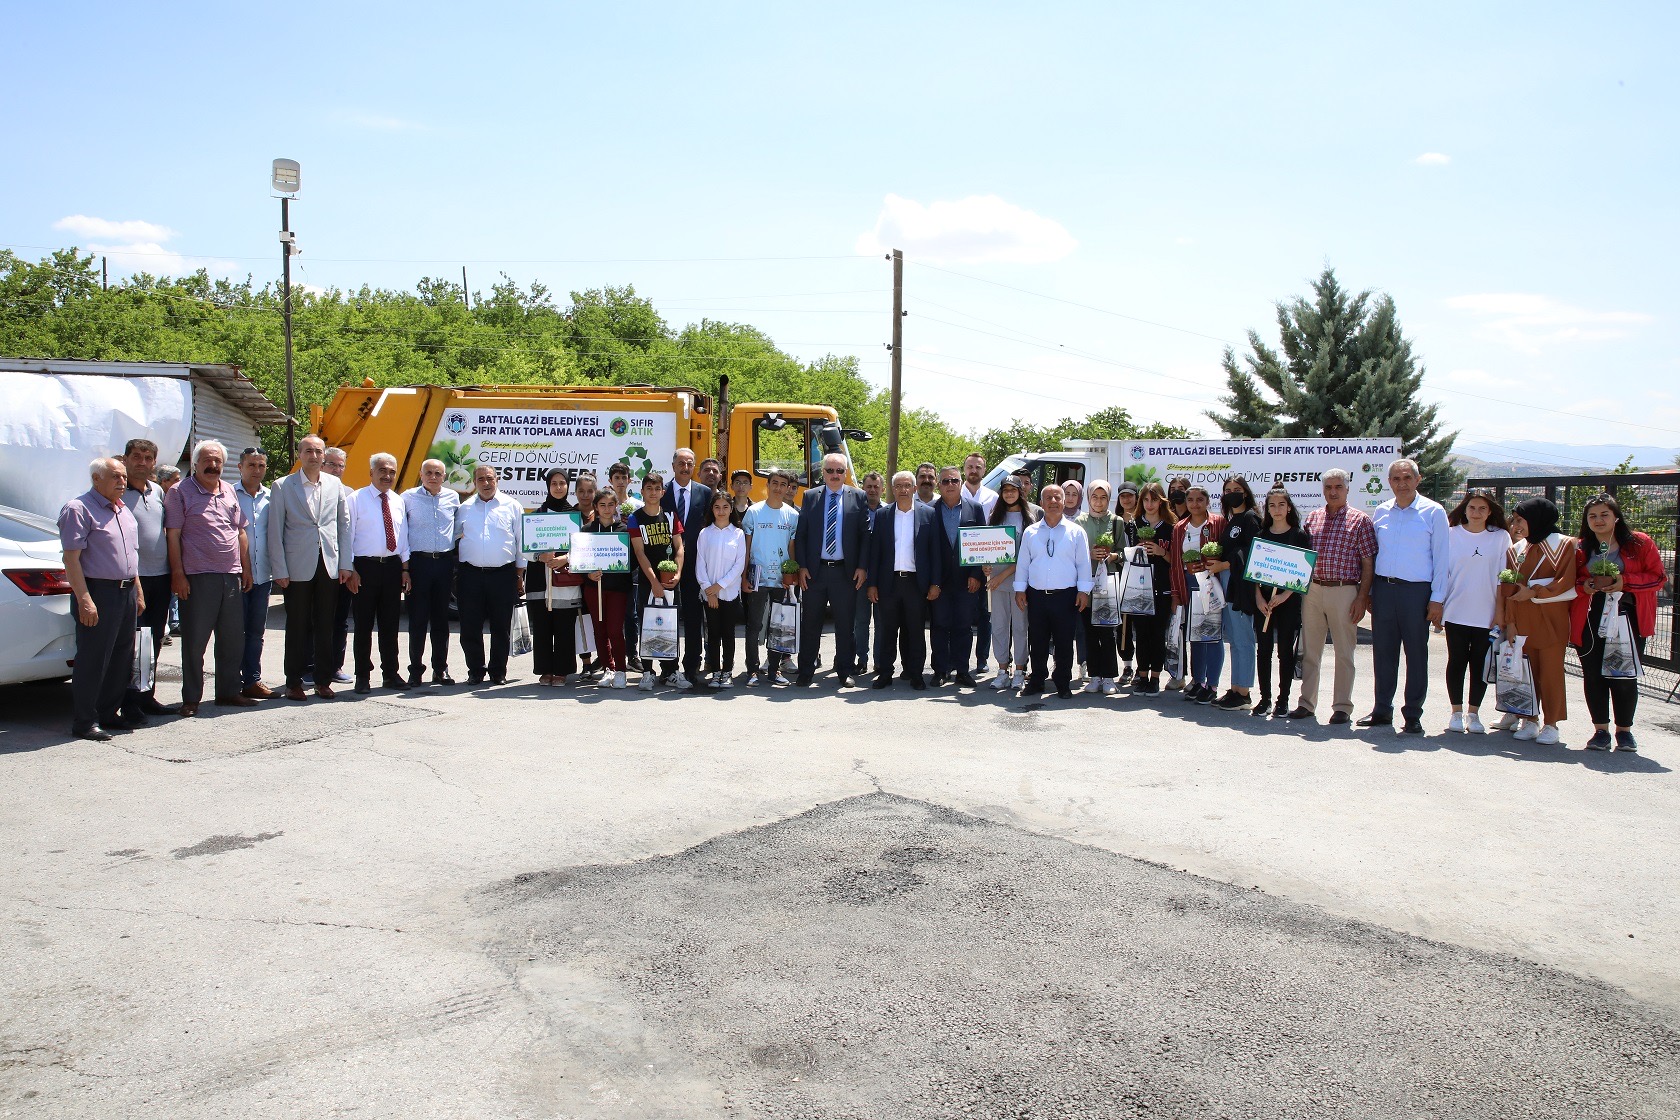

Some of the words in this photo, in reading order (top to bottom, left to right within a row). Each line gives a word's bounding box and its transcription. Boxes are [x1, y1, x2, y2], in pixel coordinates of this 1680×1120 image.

[478, 414, 539, 425] BATTALGAZİ
[541, 415, 599, 426] BELEDİYESİ
[630, 419, 653, 427] SIFIR
[472, 426, 497, 435] SIFIR
[499, 427, 521, 436] ATIK
[523, 427, 573, 437] TOPLAMA
[575, 429, 605, 437] ARACI
[630, 427, 653, 436] ATIK
[1148, 445, 1207, 456] BATTALGAZİ
[1209, 445, 1264, 455] BELEDİYESİ
[1267, 446, 1291, 455] SIFIR
[1294, 446, 1315, 455] ATIK
[1317, 446, 1364, 455] TOPLAMA
[1365, 445, 1394, 454] ARACI
[478, 450, 512, 463] GERİ
[514, 450, 599, 466] DÖNÜŞÜME
[494, 467, 549, 481] ESTEK
[1274, 472, 1322, 482] DESTEK
[646, 522, 669, 536] GREAT
[1284, 560, 1298, 569] KARA
[1288, 569, 1306, 578] YAPMA
